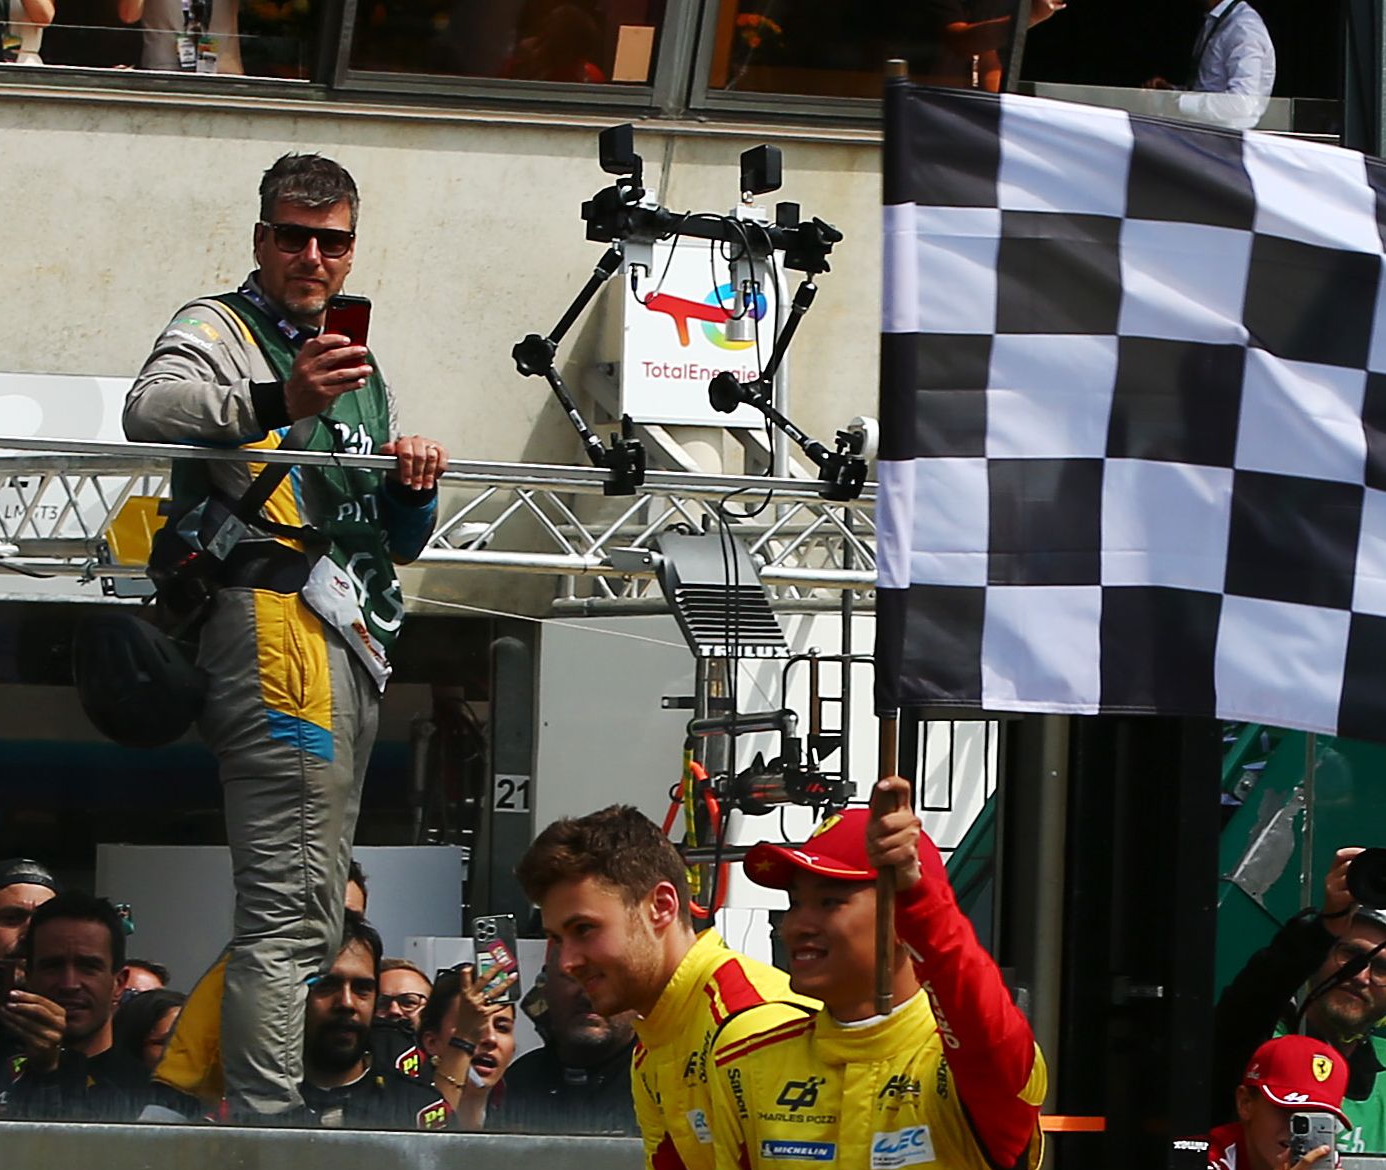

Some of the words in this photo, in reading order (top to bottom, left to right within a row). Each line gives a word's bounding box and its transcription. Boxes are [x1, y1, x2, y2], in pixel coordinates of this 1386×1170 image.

[497, 777, 531, 811] 21
[773, 1145, 828, 1156] MICHELIN
[874, 1130, 927, 1154] WEC
